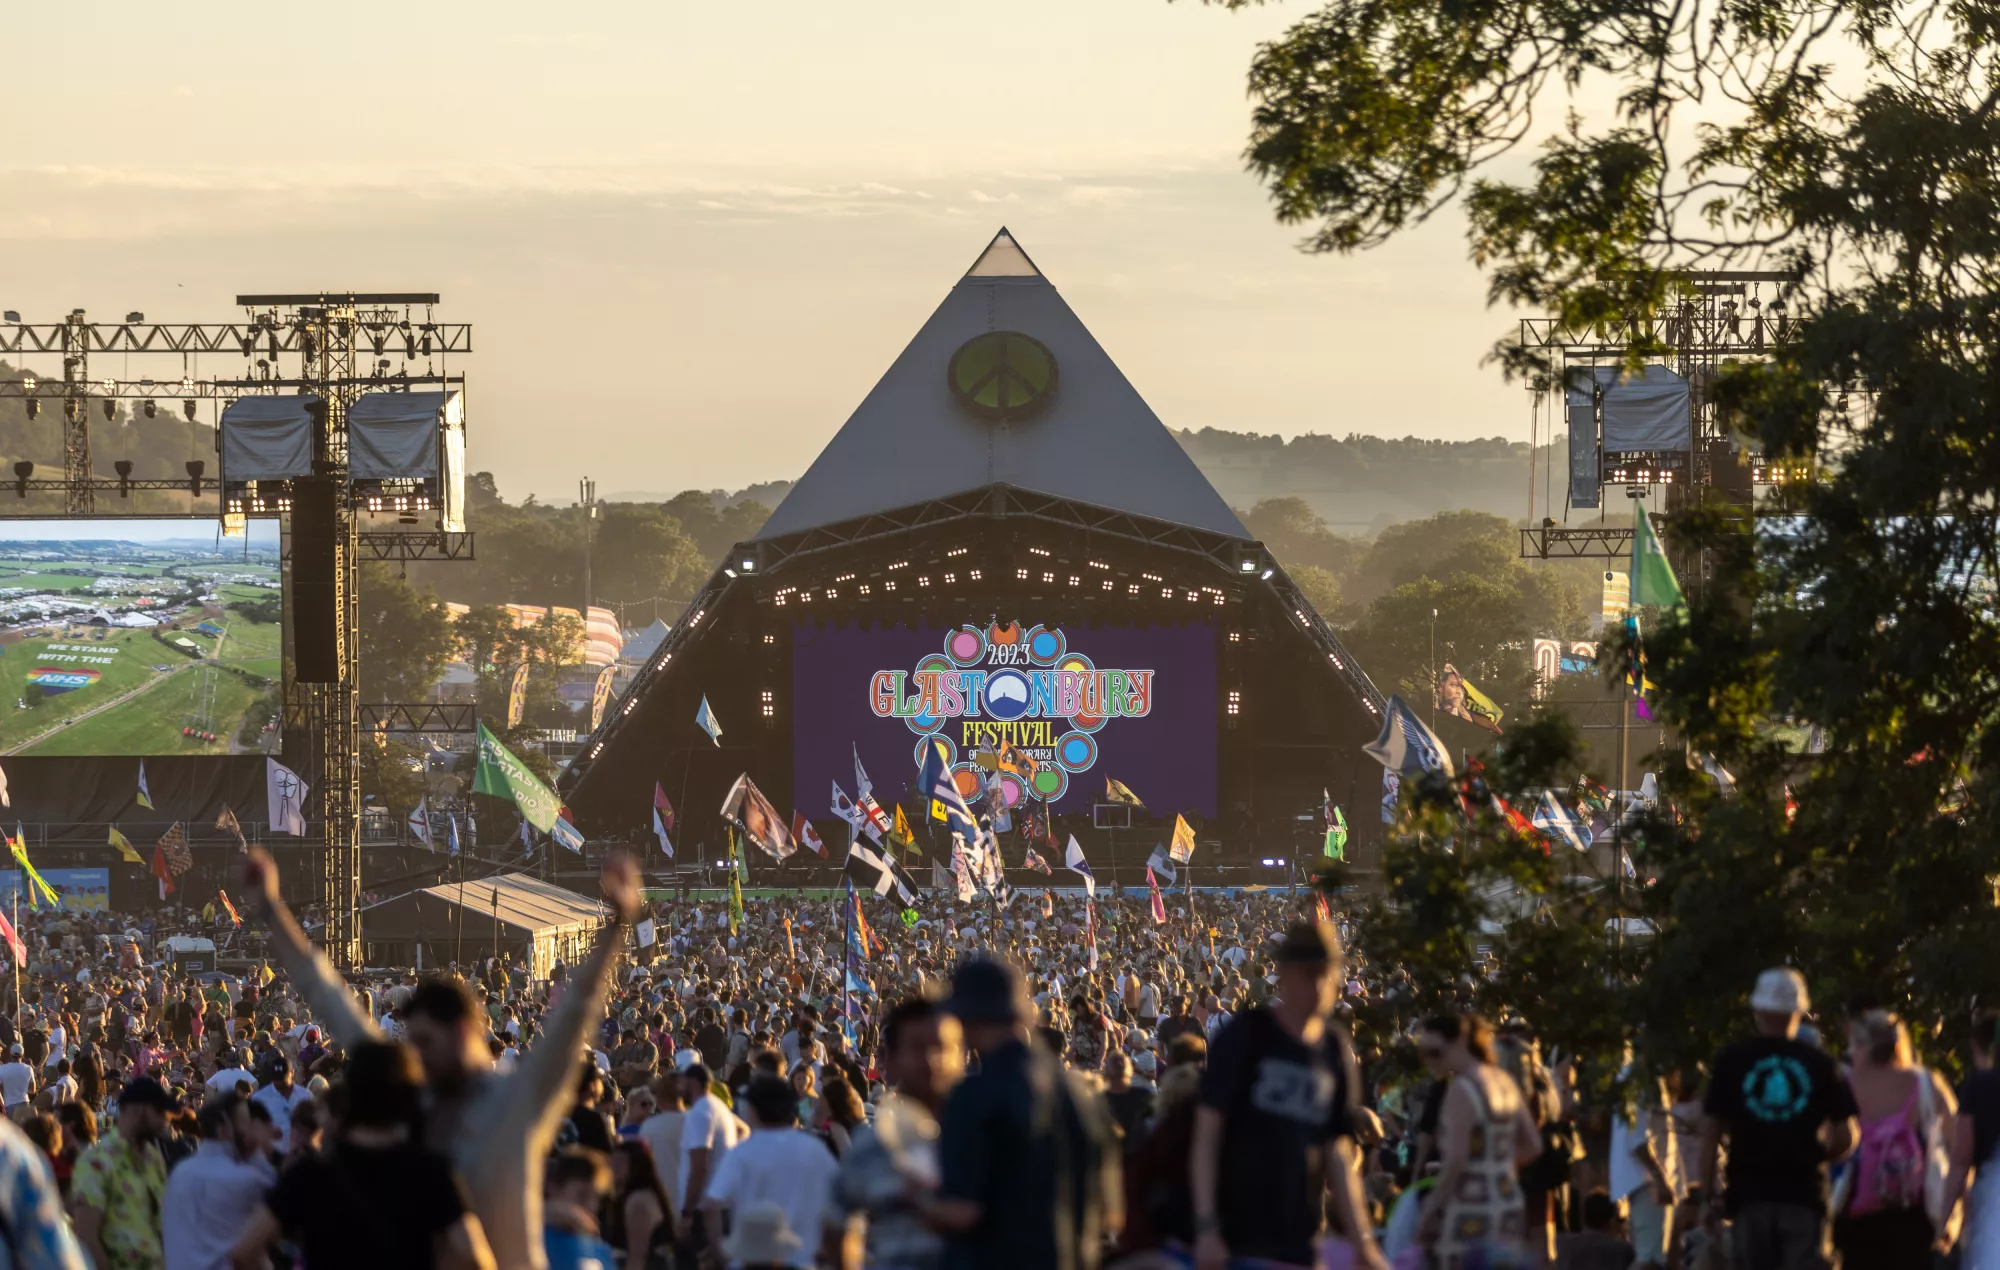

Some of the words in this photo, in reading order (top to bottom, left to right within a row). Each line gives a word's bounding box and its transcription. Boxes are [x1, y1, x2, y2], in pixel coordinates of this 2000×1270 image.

[48, 643, 69, 651] WE
[71, 645, 119, 654] STAND
[987, 643, 1031, 665] 2023
[37, 653, 77, 662] WITH
[81, 655, 113, 664] THE
[36, 673, 88, 684] NHS
[961, 721, 1059, 747] FESTIVAL
